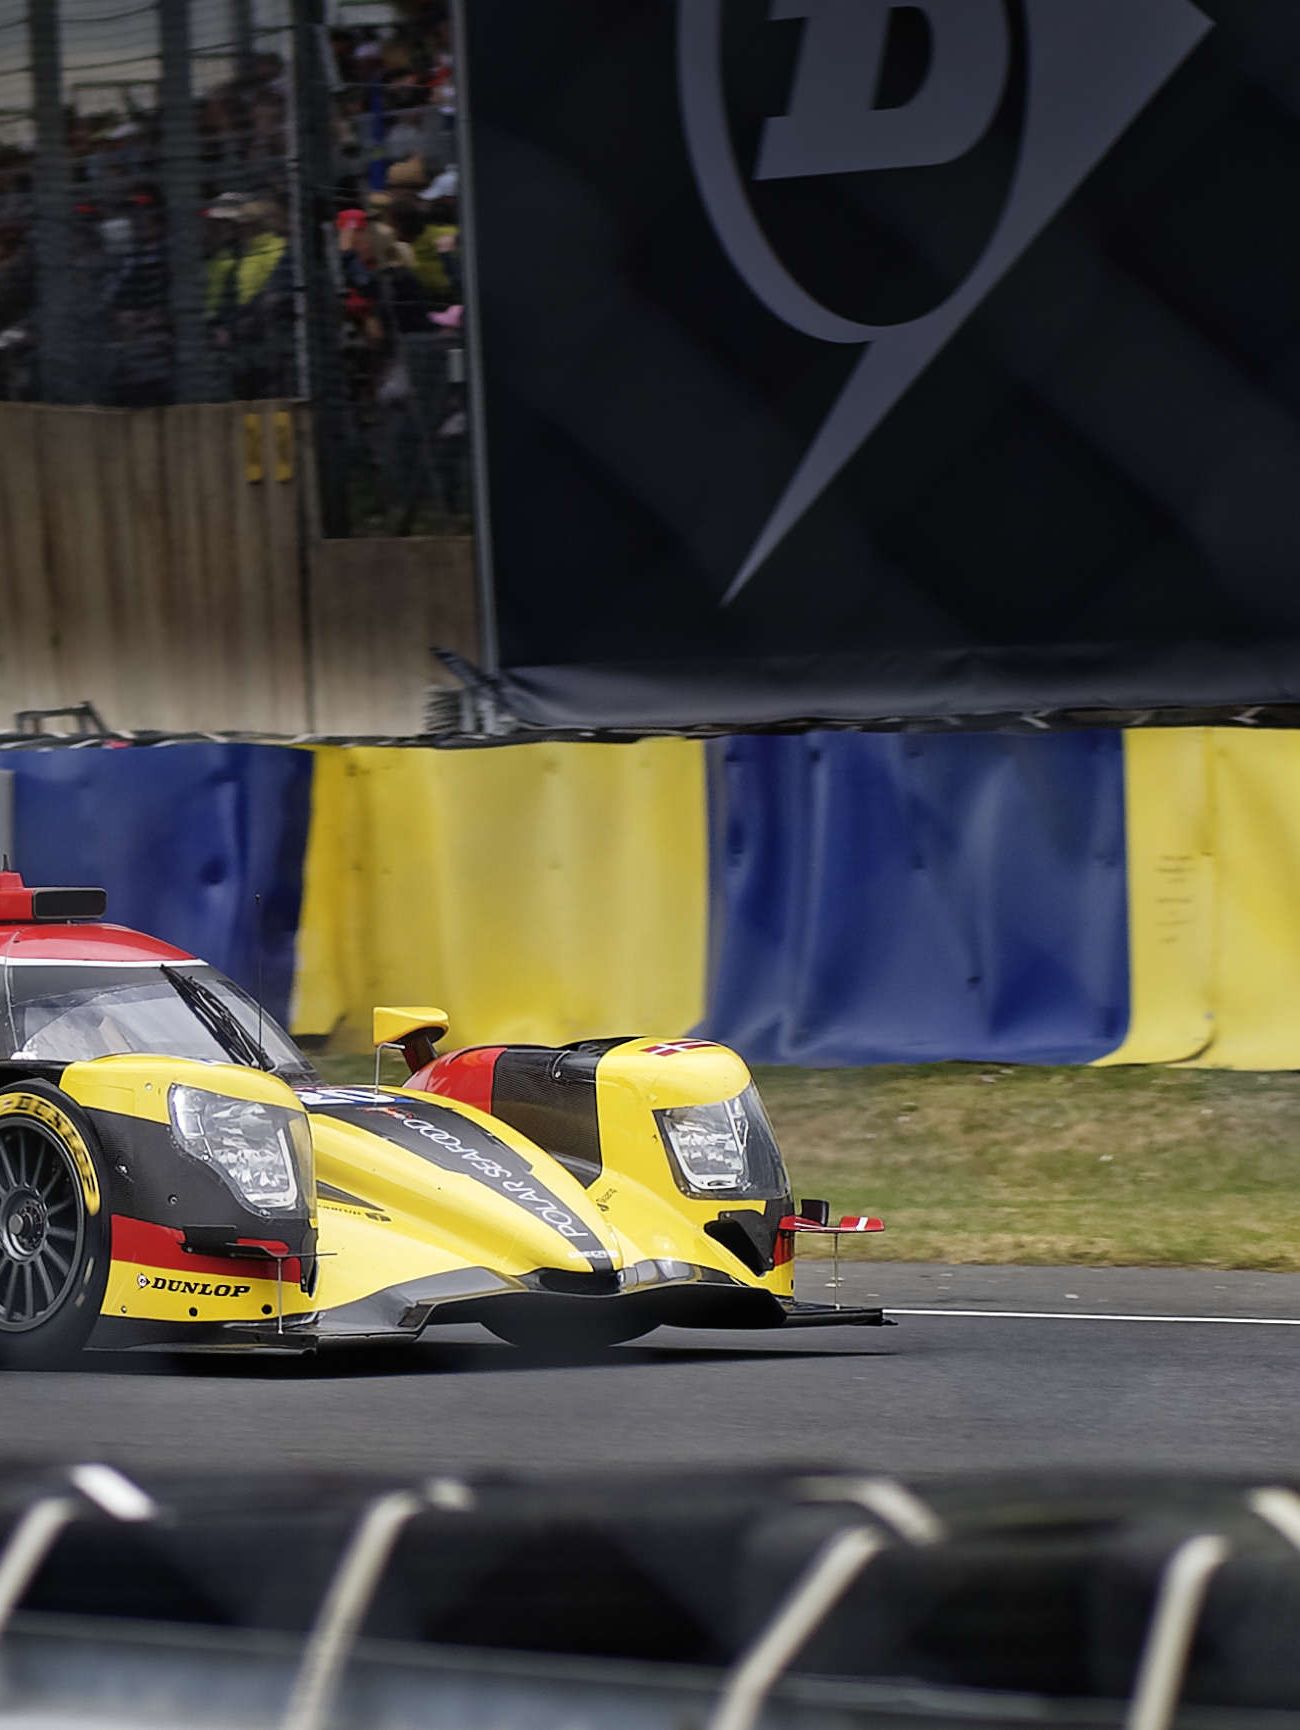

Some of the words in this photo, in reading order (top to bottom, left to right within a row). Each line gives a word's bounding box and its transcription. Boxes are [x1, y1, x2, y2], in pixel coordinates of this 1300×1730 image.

[403, 1118, 514, 1178] SEAFOOD
[504, 1179, 588, 1239] POLAR
[151, 1277, 251, 1297] DUNLOP
